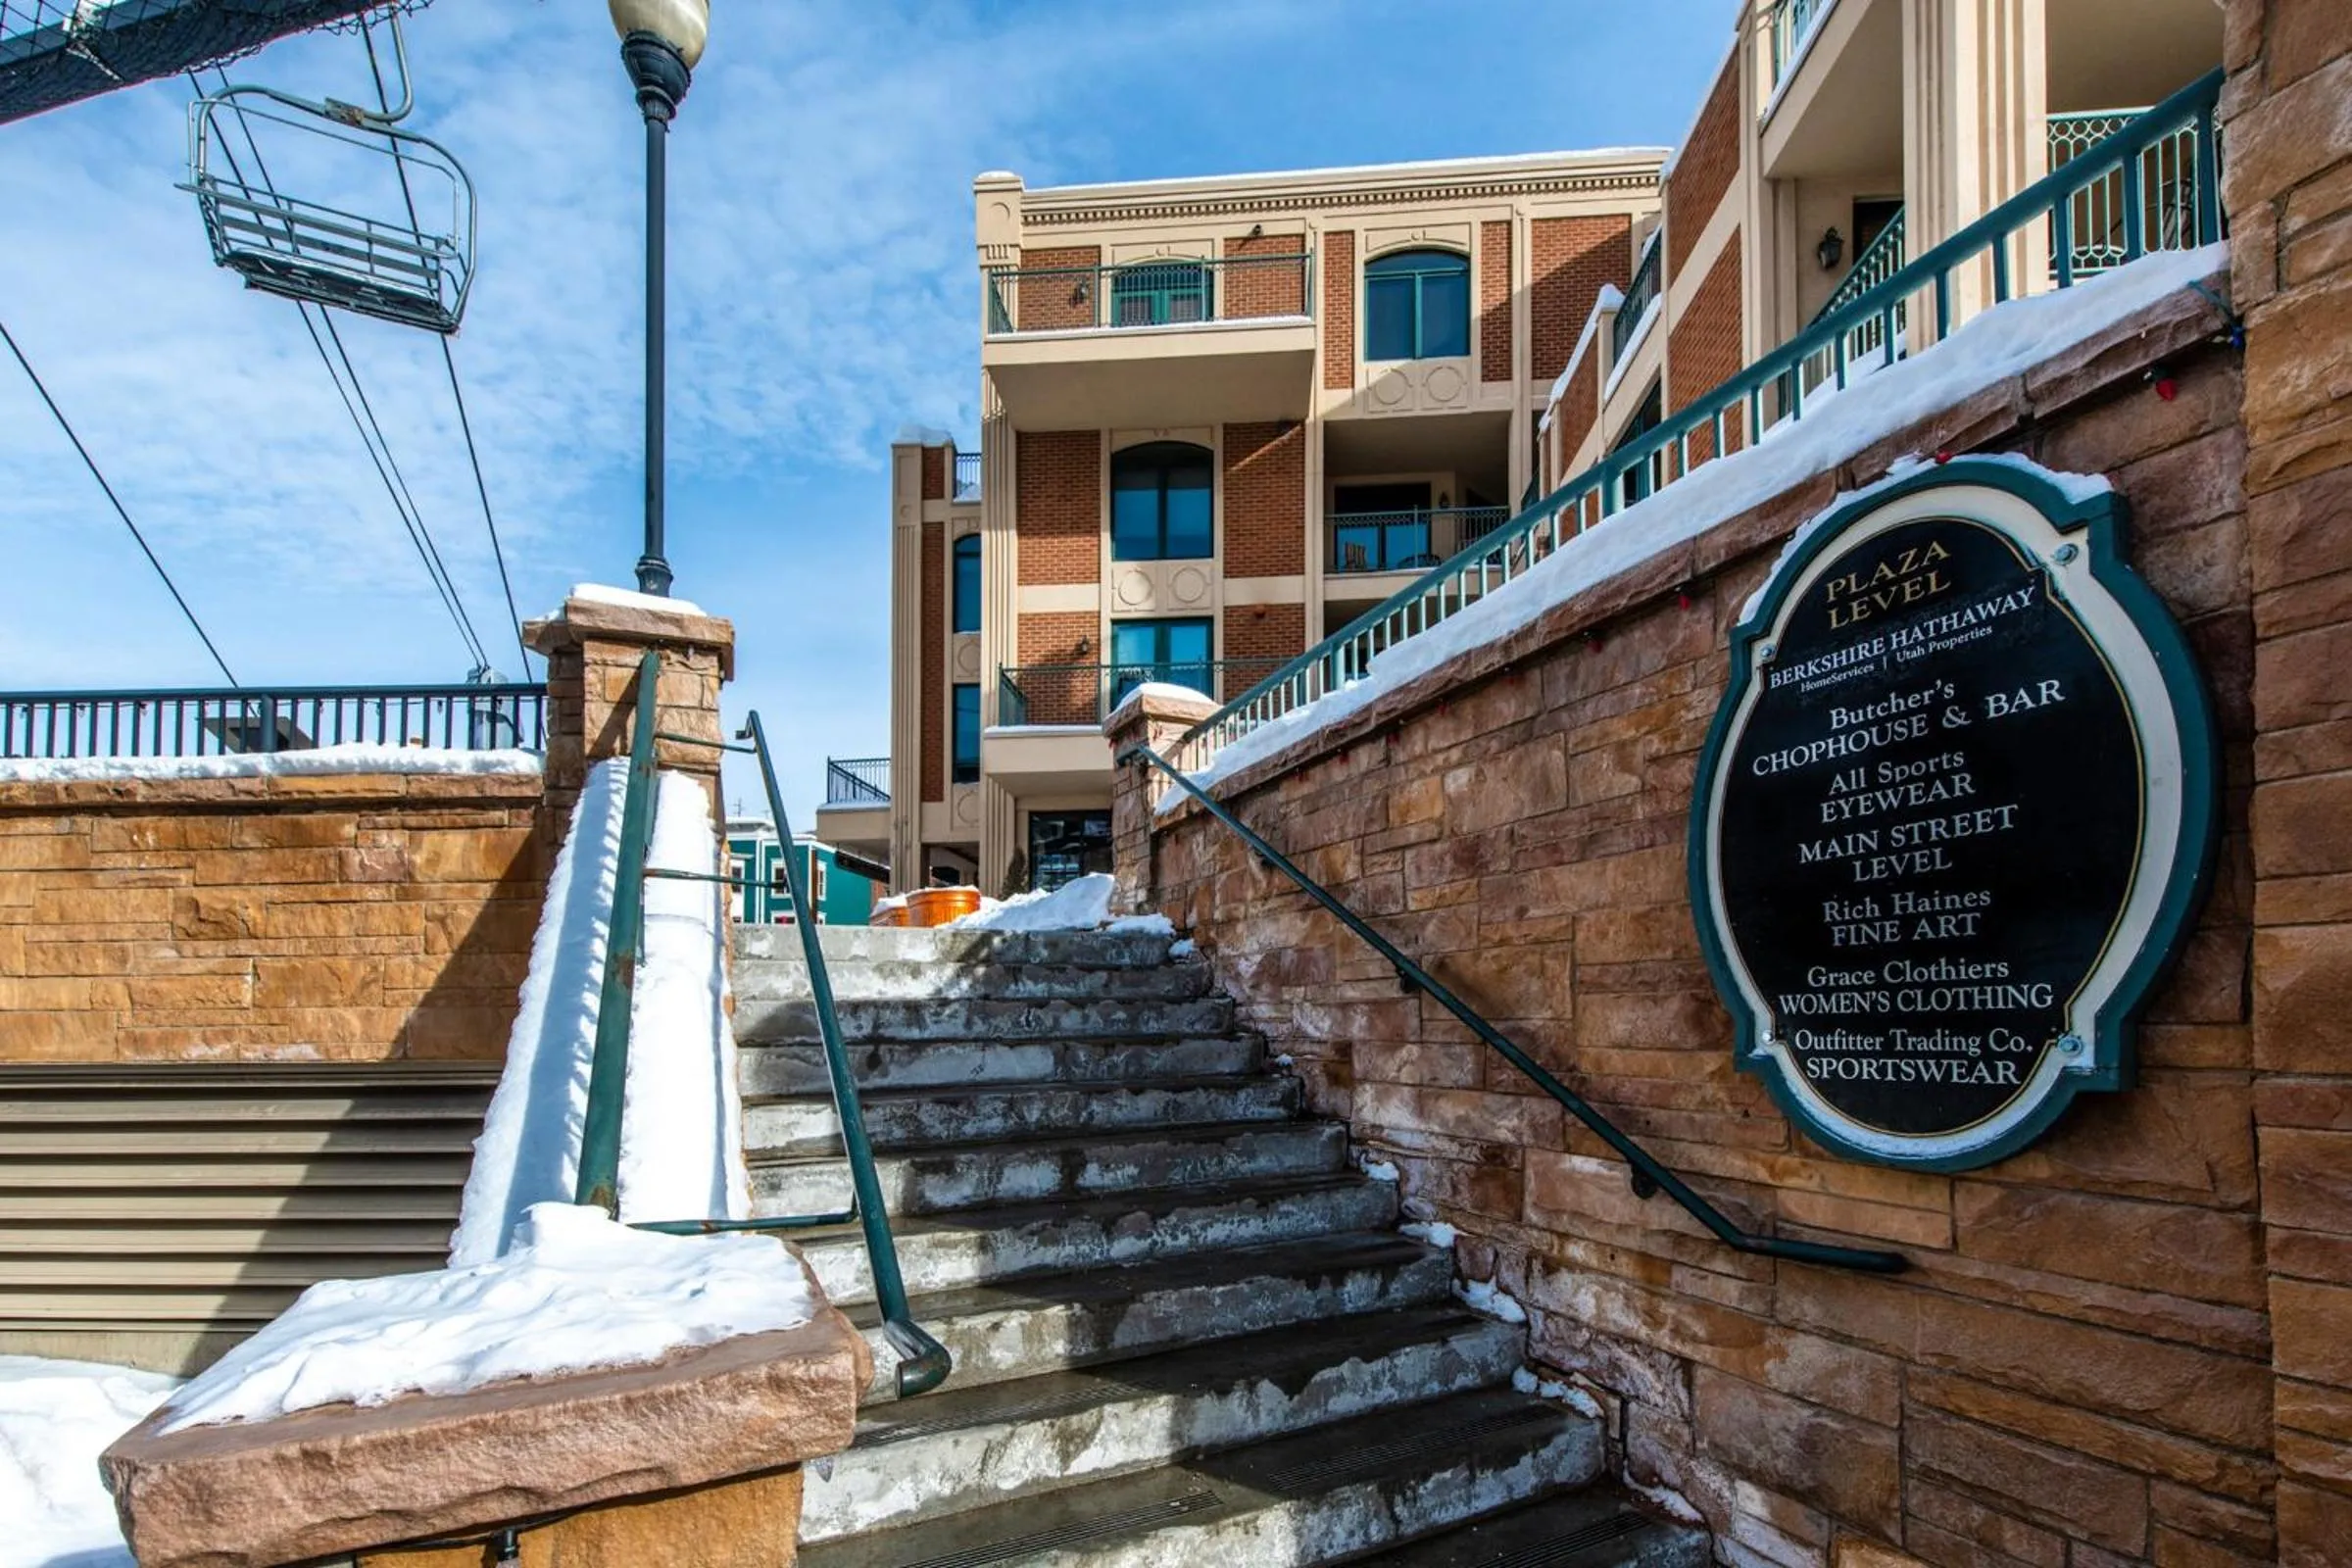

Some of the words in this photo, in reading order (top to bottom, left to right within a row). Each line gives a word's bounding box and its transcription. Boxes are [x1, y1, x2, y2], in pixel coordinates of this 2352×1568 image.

[1827, 541, 1951, 602] PLAZA
[1829, 570, 1951, 630] LEVEL
[1769, 639, 1886, 689] BERKSHIRE
[1890, 586, 2036, 650] HATHAWAY
[1800, 662, 1875, 691] HomeServices
[1896, 642, 1925, 663] Utah
[1929, 624, 1992, 657] Properties
[1753, 716, 1930, 775] CHOPHOUSE
[1942, 706, 1972, 727] &
[1985, 680, 2065, 718] BAR
[1830, 680, 1954, 729] Butcher's
[1829, 767, 1865, 795] All
[1878, 752, 1965, 786] Sports
[1821, 773, 1976, 823] EYEWEAR
[1798, 831, 1879, 862] MAIN
[1891, 805, 2019, 849] STREET
[1852, 849, 1952, 881] LEVEL
[1823, 897, 1880, 923] Rich
[1893, 890, 1990, 914] Haines
[1833, 922, 1901, 946] FINE
[1913, 913, 1982, 940] ART
[1807, 966, 1875, 988] Grace
[1884, 959, 2009, 983] Clothiers
[1780, 991, 1890, 1015] WOMEN'S
[1896, 984, 2053, 1011] CLOTHING
[1795, 1029, 1884, 1052] Outfitter
[1889, 1028, 1982, 1055] Trading
[1988, 1029, 2034, 1053] Co.
[1806, 1058, 2021, 1085] SPORTSWEAR
